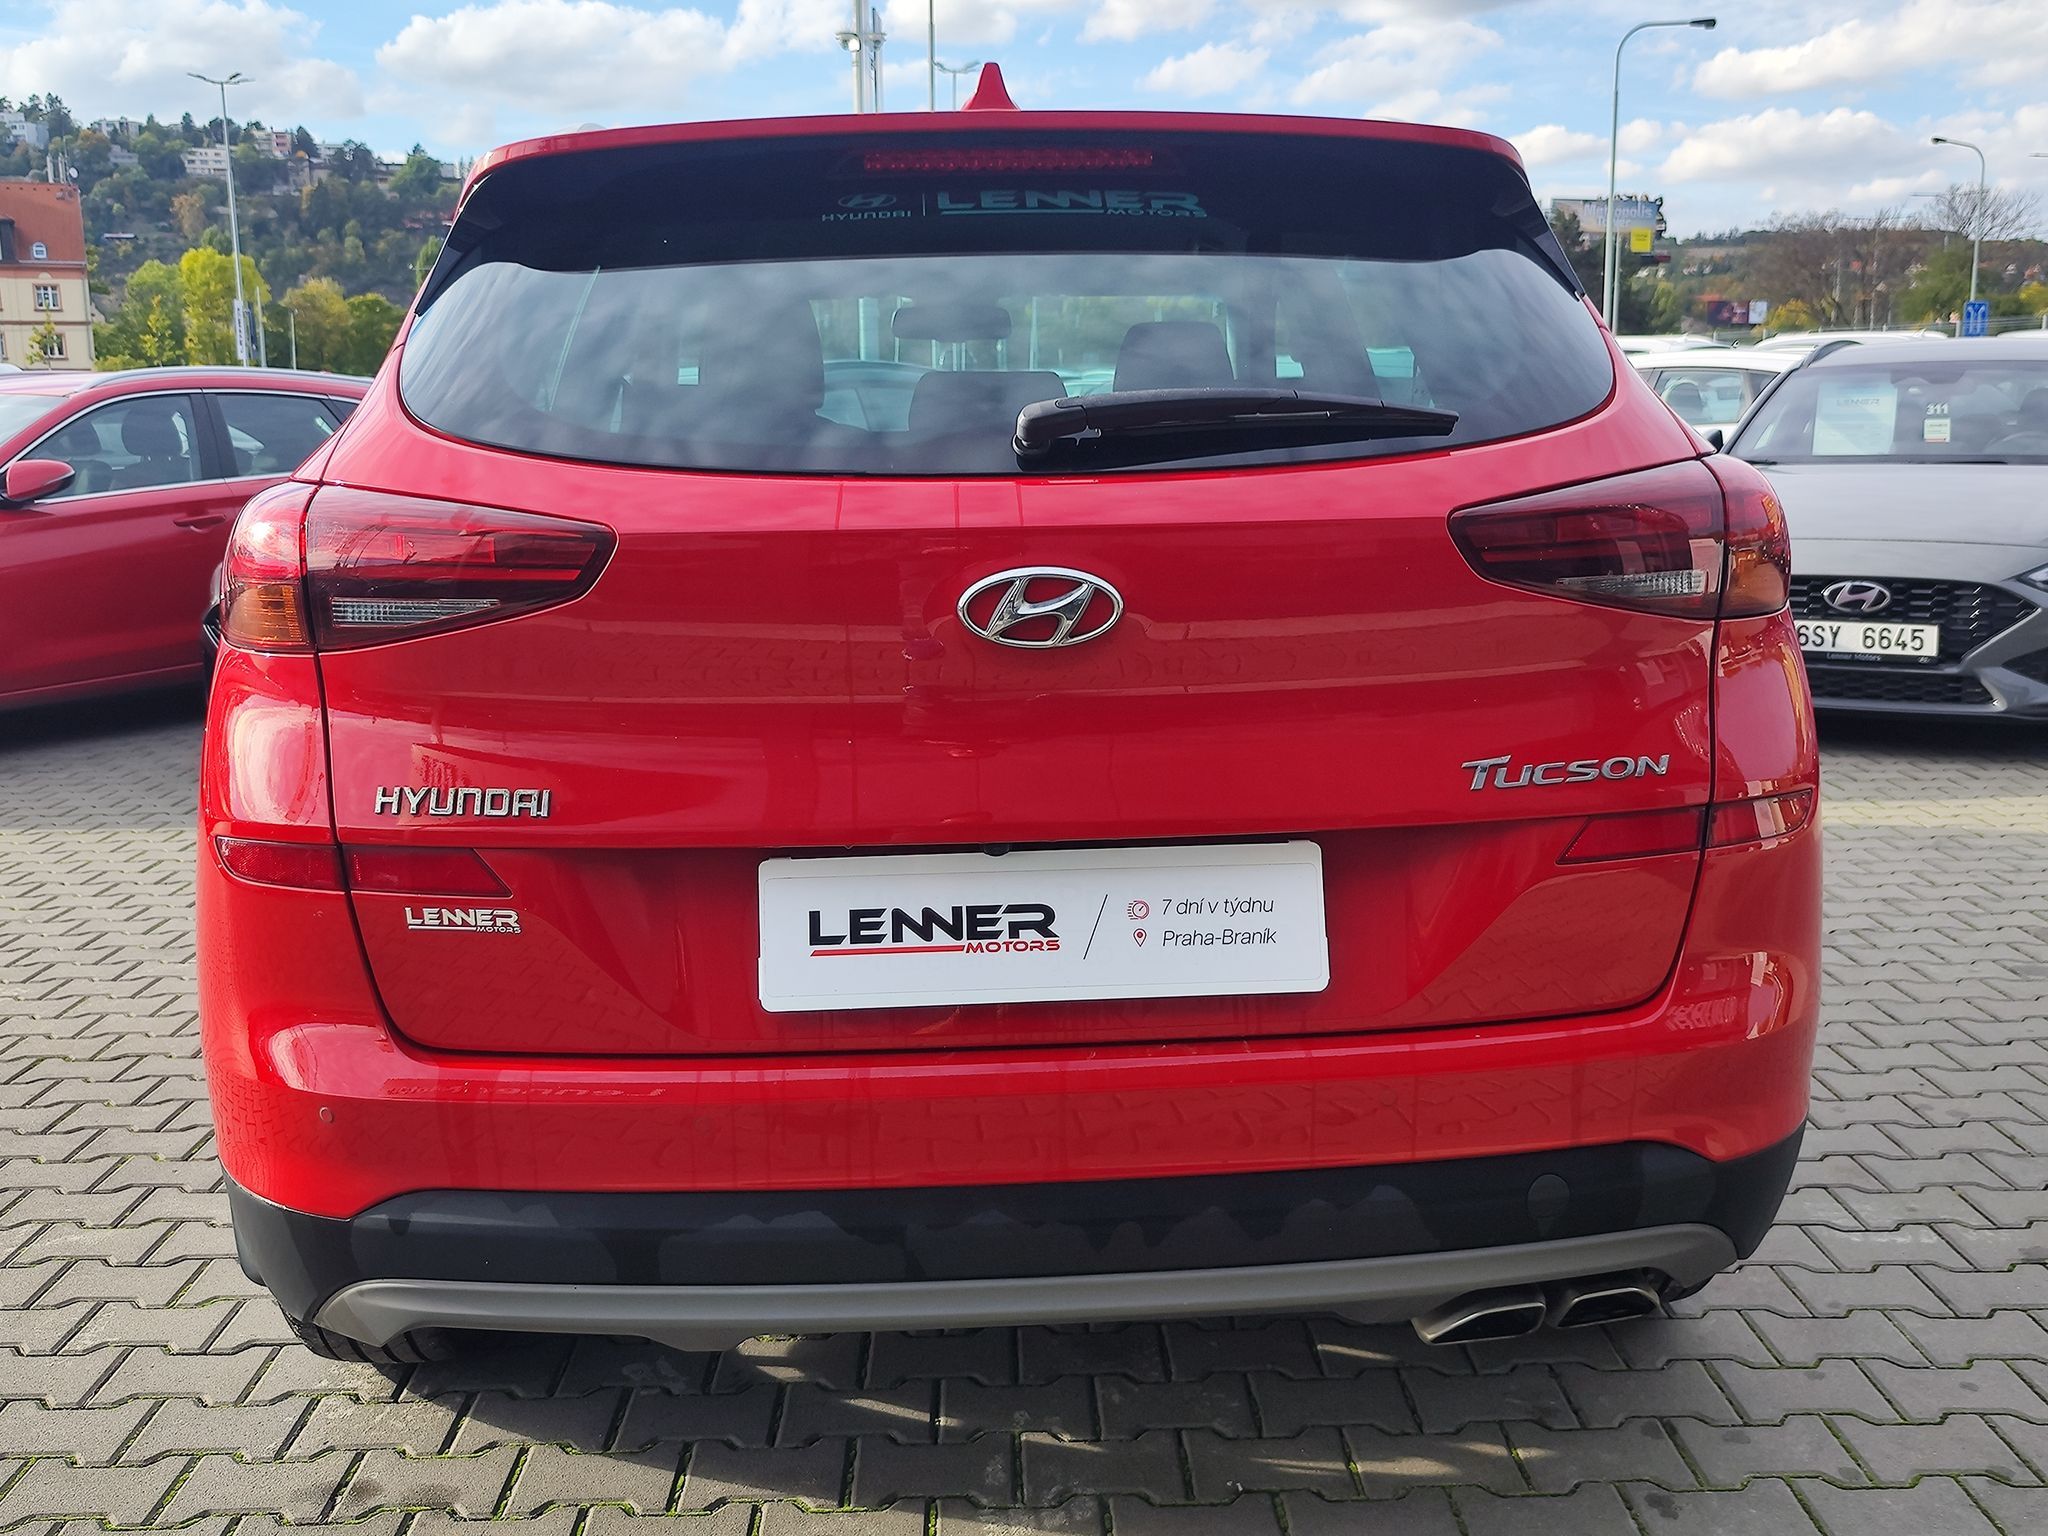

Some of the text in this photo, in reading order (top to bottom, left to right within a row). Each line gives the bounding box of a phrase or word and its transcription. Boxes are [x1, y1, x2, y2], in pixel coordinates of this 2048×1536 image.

[937, 189, 1202, 209] LENNER
[821, 210, 912, 222] HYUNDAI
[1106, 208, 1208, 218] MOTORS
[1926, 402, 1949, 415] 311
[1797, 624, 1925, 651] 6SY 6645
[374, 785, 551, 818] HYUNDAI
[404, 907, 520, 927] LENNER
[1162, 896, 1275, 918] 7 dní v týdnu
[475, 925, 522, 934] MOTORS
[808, 903, 1061, 946] LENNER
[965, 939, 1061, 954] MOTORS
[1162, 927, 1278, 947] Praha-Braník
